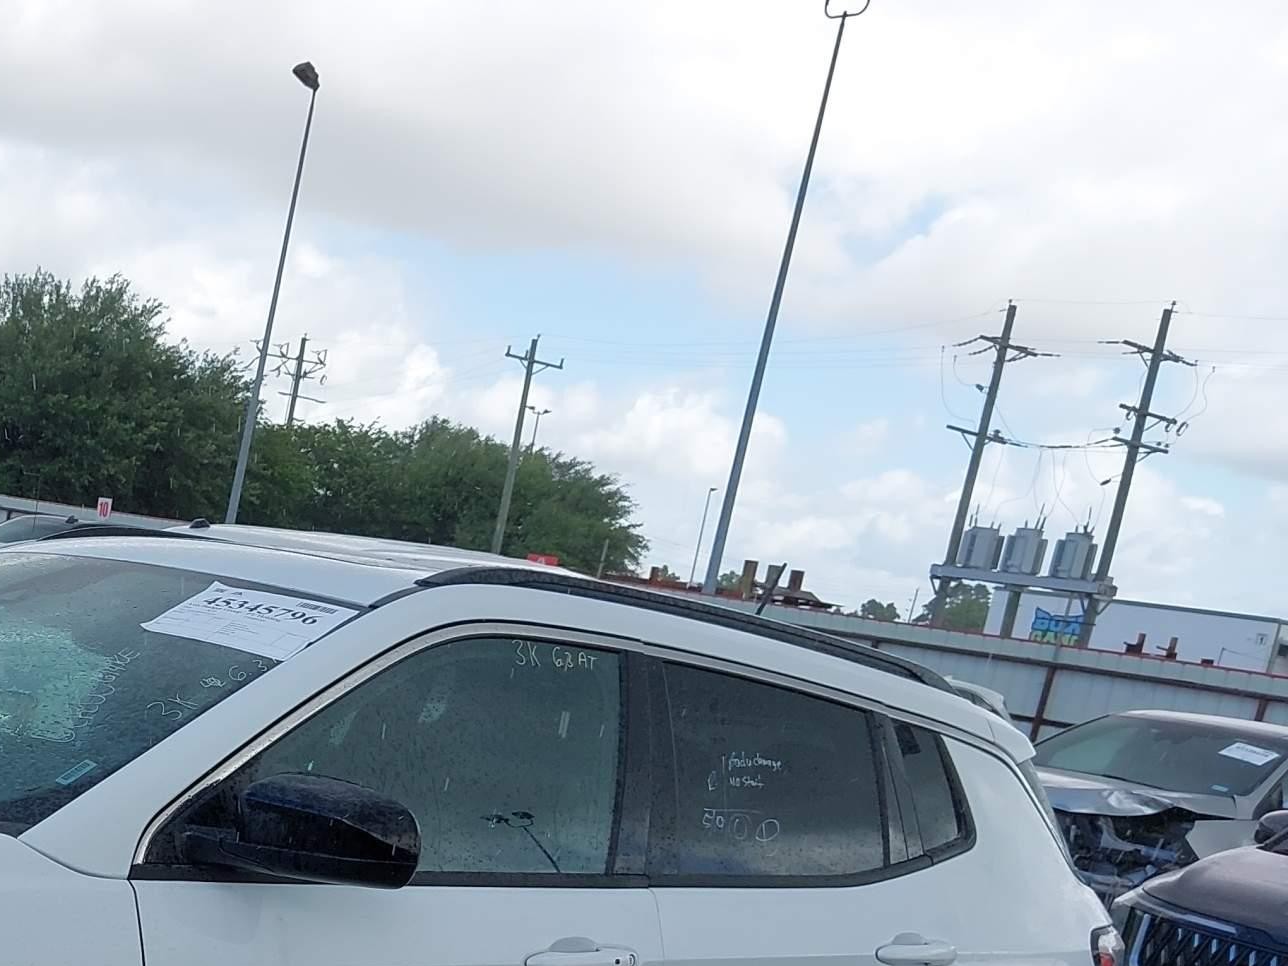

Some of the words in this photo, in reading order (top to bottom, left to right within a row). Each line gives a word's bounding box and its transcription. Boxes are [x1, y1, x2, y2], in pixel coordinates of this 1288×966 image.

[99, 501, 109, 518] 10
[203, 596, 319, 626] 45345796
[512, 639, 541, 668] 3K
